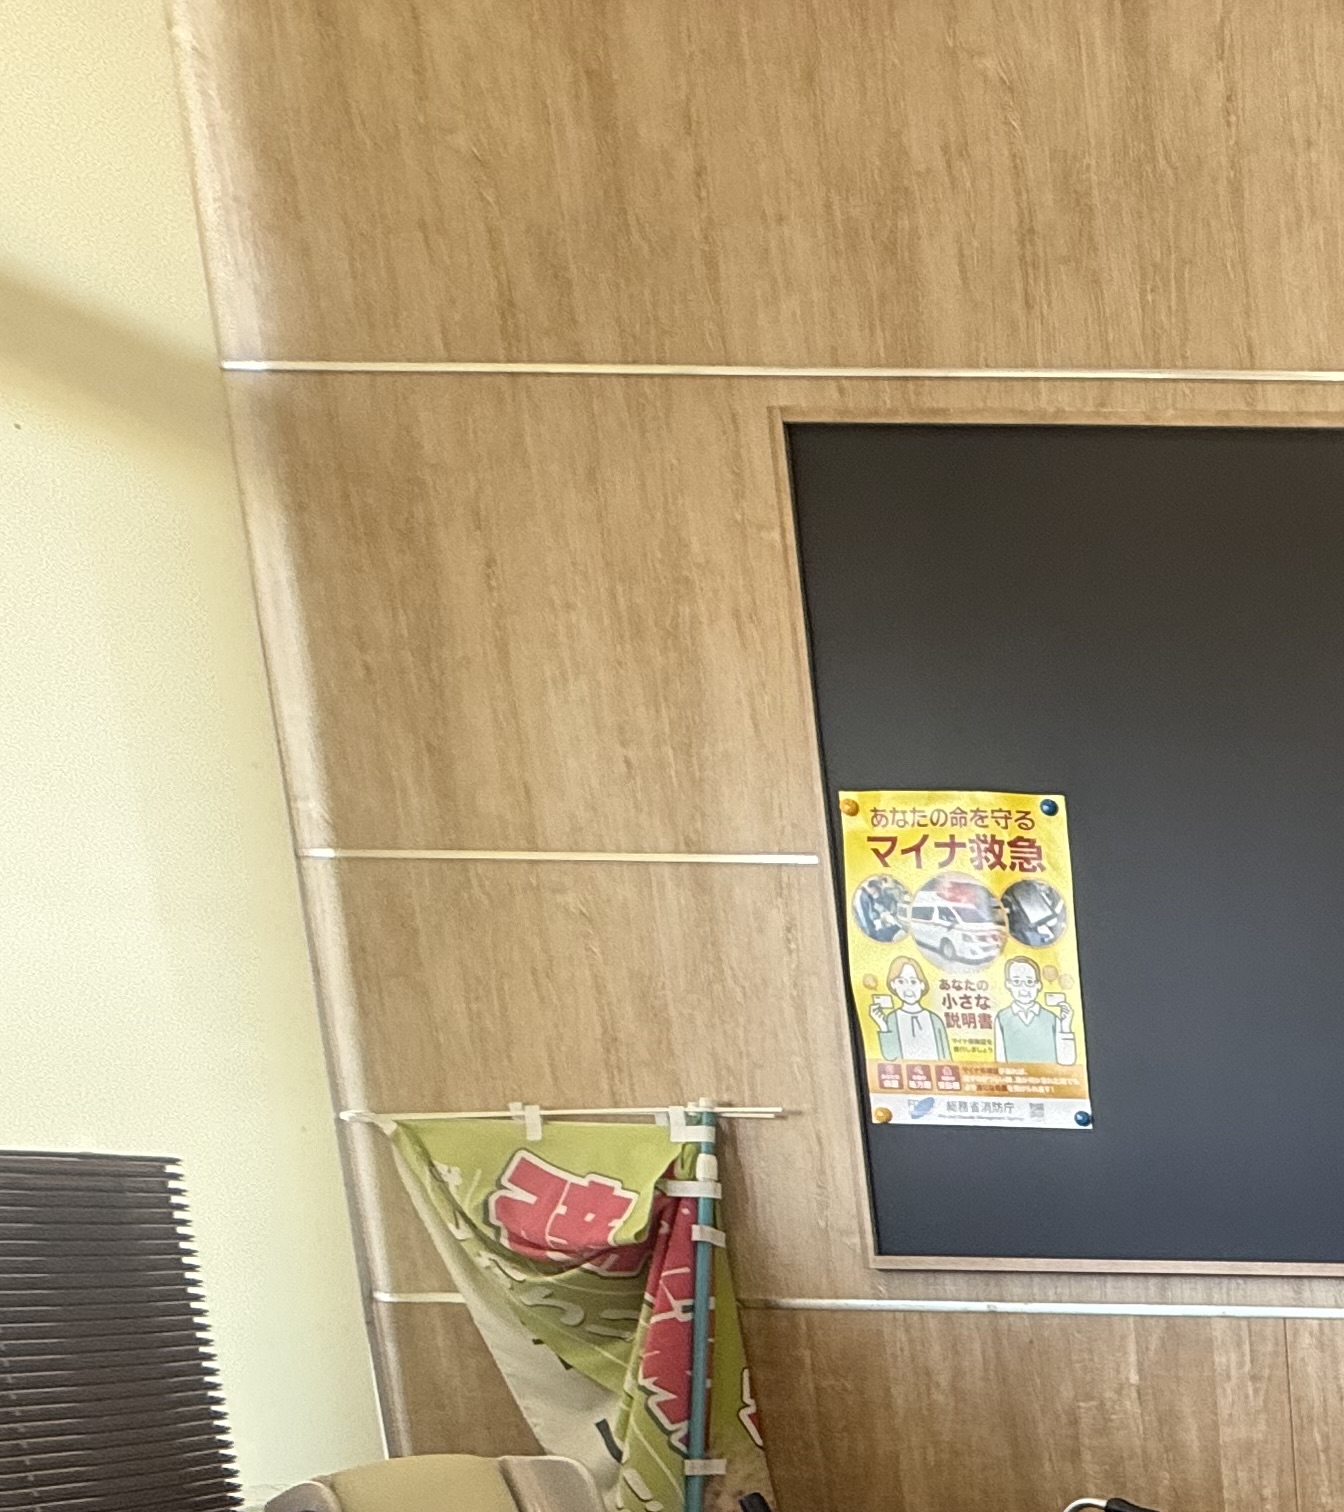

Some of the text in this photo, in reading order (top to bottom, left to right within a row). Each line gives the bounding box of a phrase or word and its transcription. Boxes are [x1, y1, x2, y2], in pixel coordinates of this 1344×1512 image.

[870, 807, 1036, 830] あなたの命を守る
[867, 834, 1046, 872] マイナ救急
[939, 979, 989, 992] あなたの
[942, 994, 991, 1011] 小さな
[944, 1013, 993, 1030] 説明書
[946, 1100, 1015, 1115] 総務省消防庁
